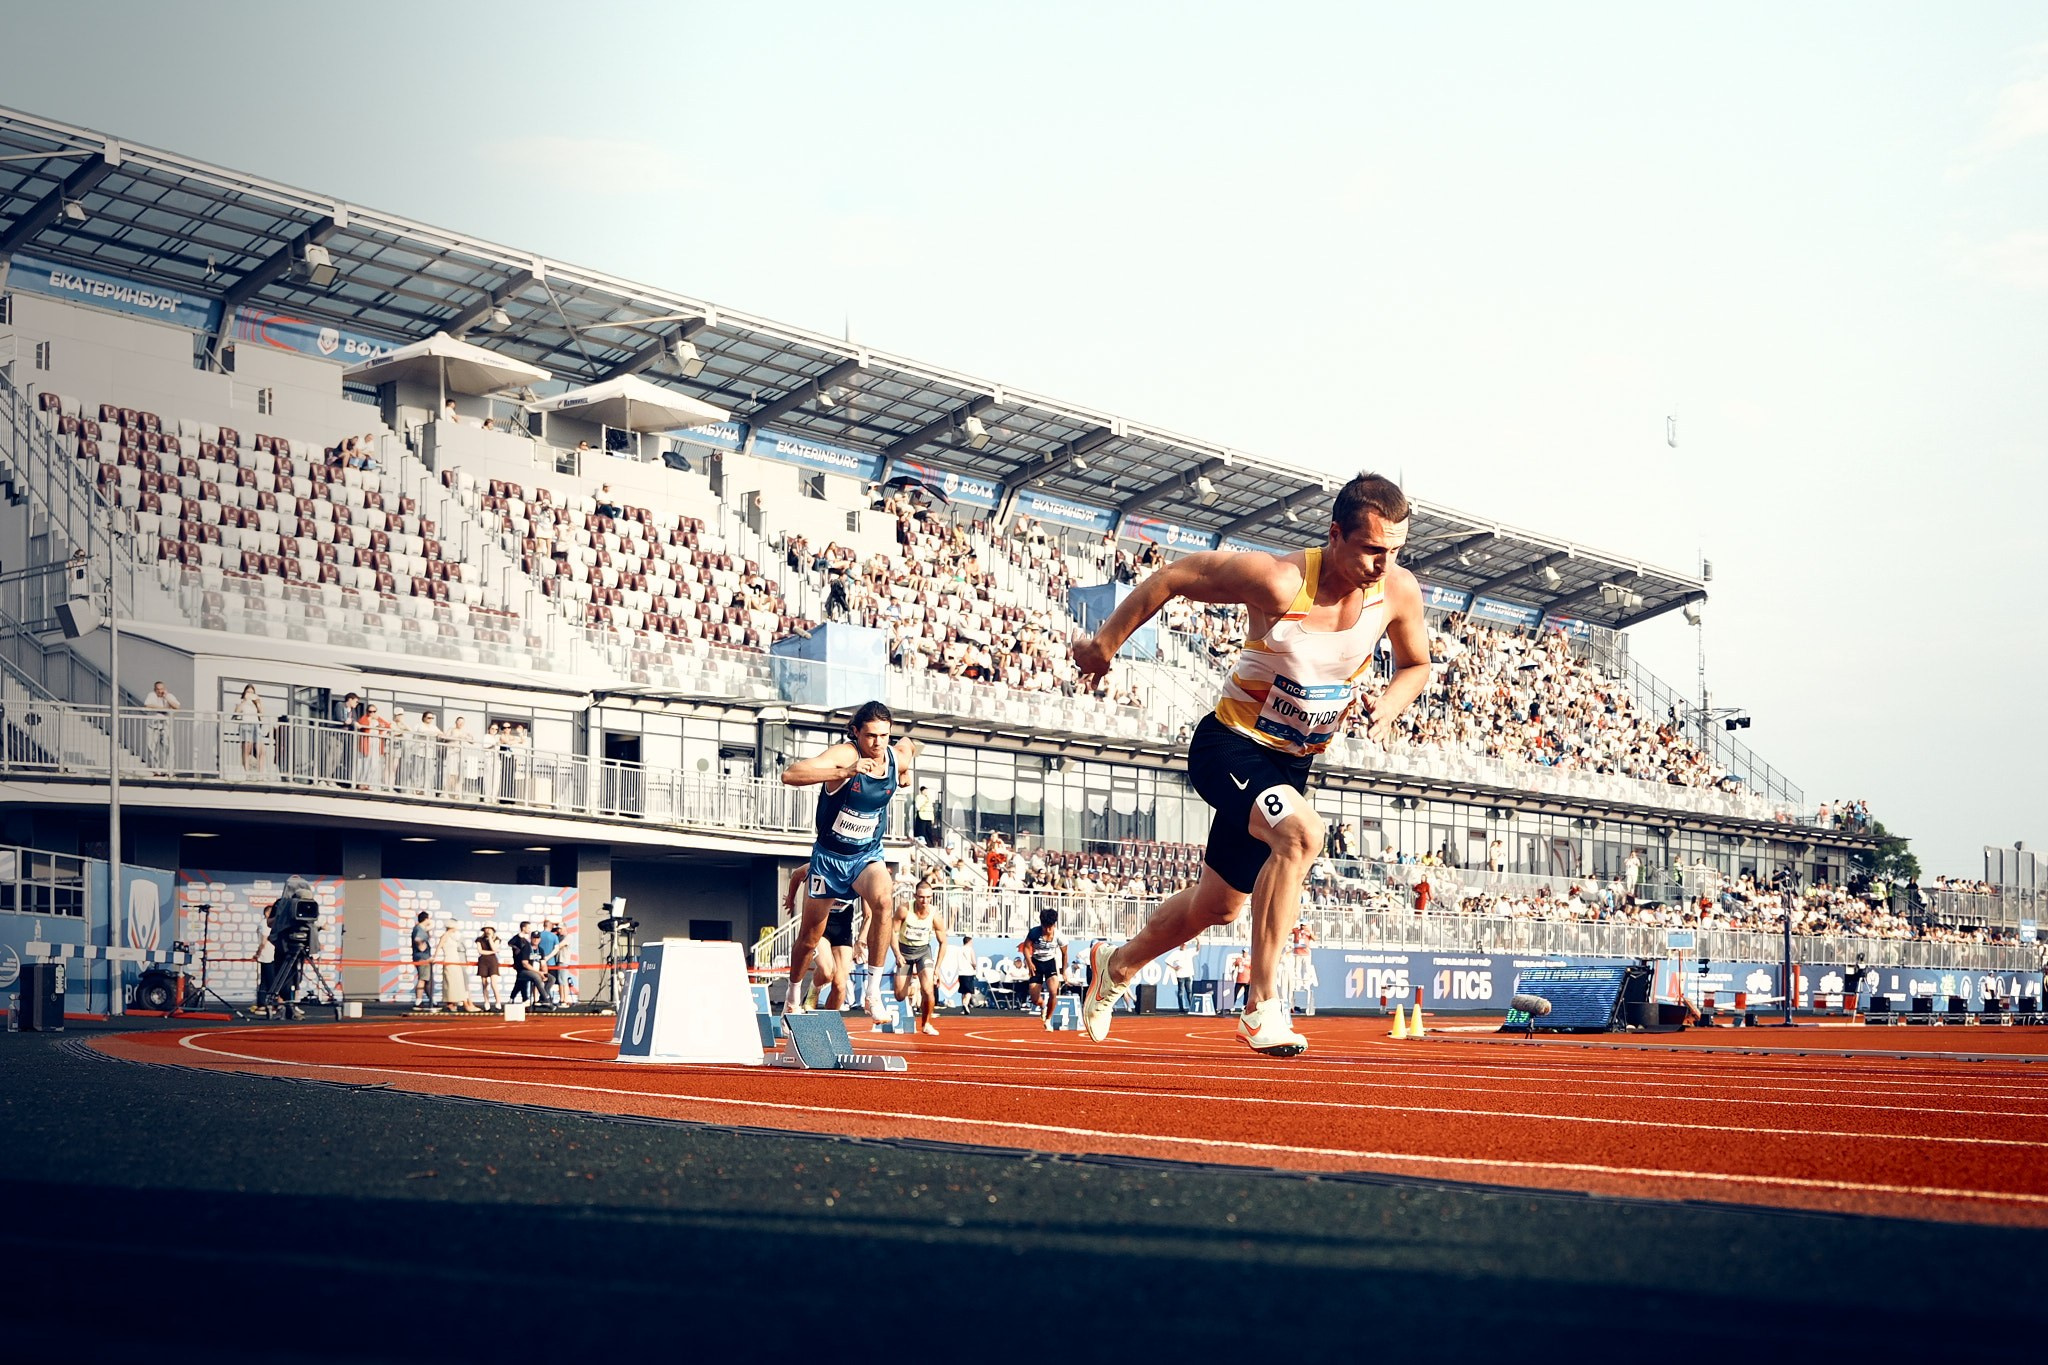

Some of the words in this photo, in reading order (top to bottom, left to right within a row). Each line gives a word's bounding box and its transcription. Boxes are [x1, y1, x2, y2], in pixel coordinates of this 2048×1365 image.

[49, 271, 182, 313] ЕКАТЕРИНБУРГ
[344, 338, 393, 358] ВФЛ
[776, 440, 859, 469] EKATERINBURG
[961, 480, 994, 499] ВФЛА
[1286, 684, 1307, 697] ПСБ
[1271, 696, 1338, 727] КОРОТКОВ
[1264, 794, 1283, 816] 8
[814, 878, 822, 891] 7
[1366, 968, 1410, 999] ПСБ
[1453, 970, 1493, 1000] ПСБ
[632, 983, 651, 1046] 8
